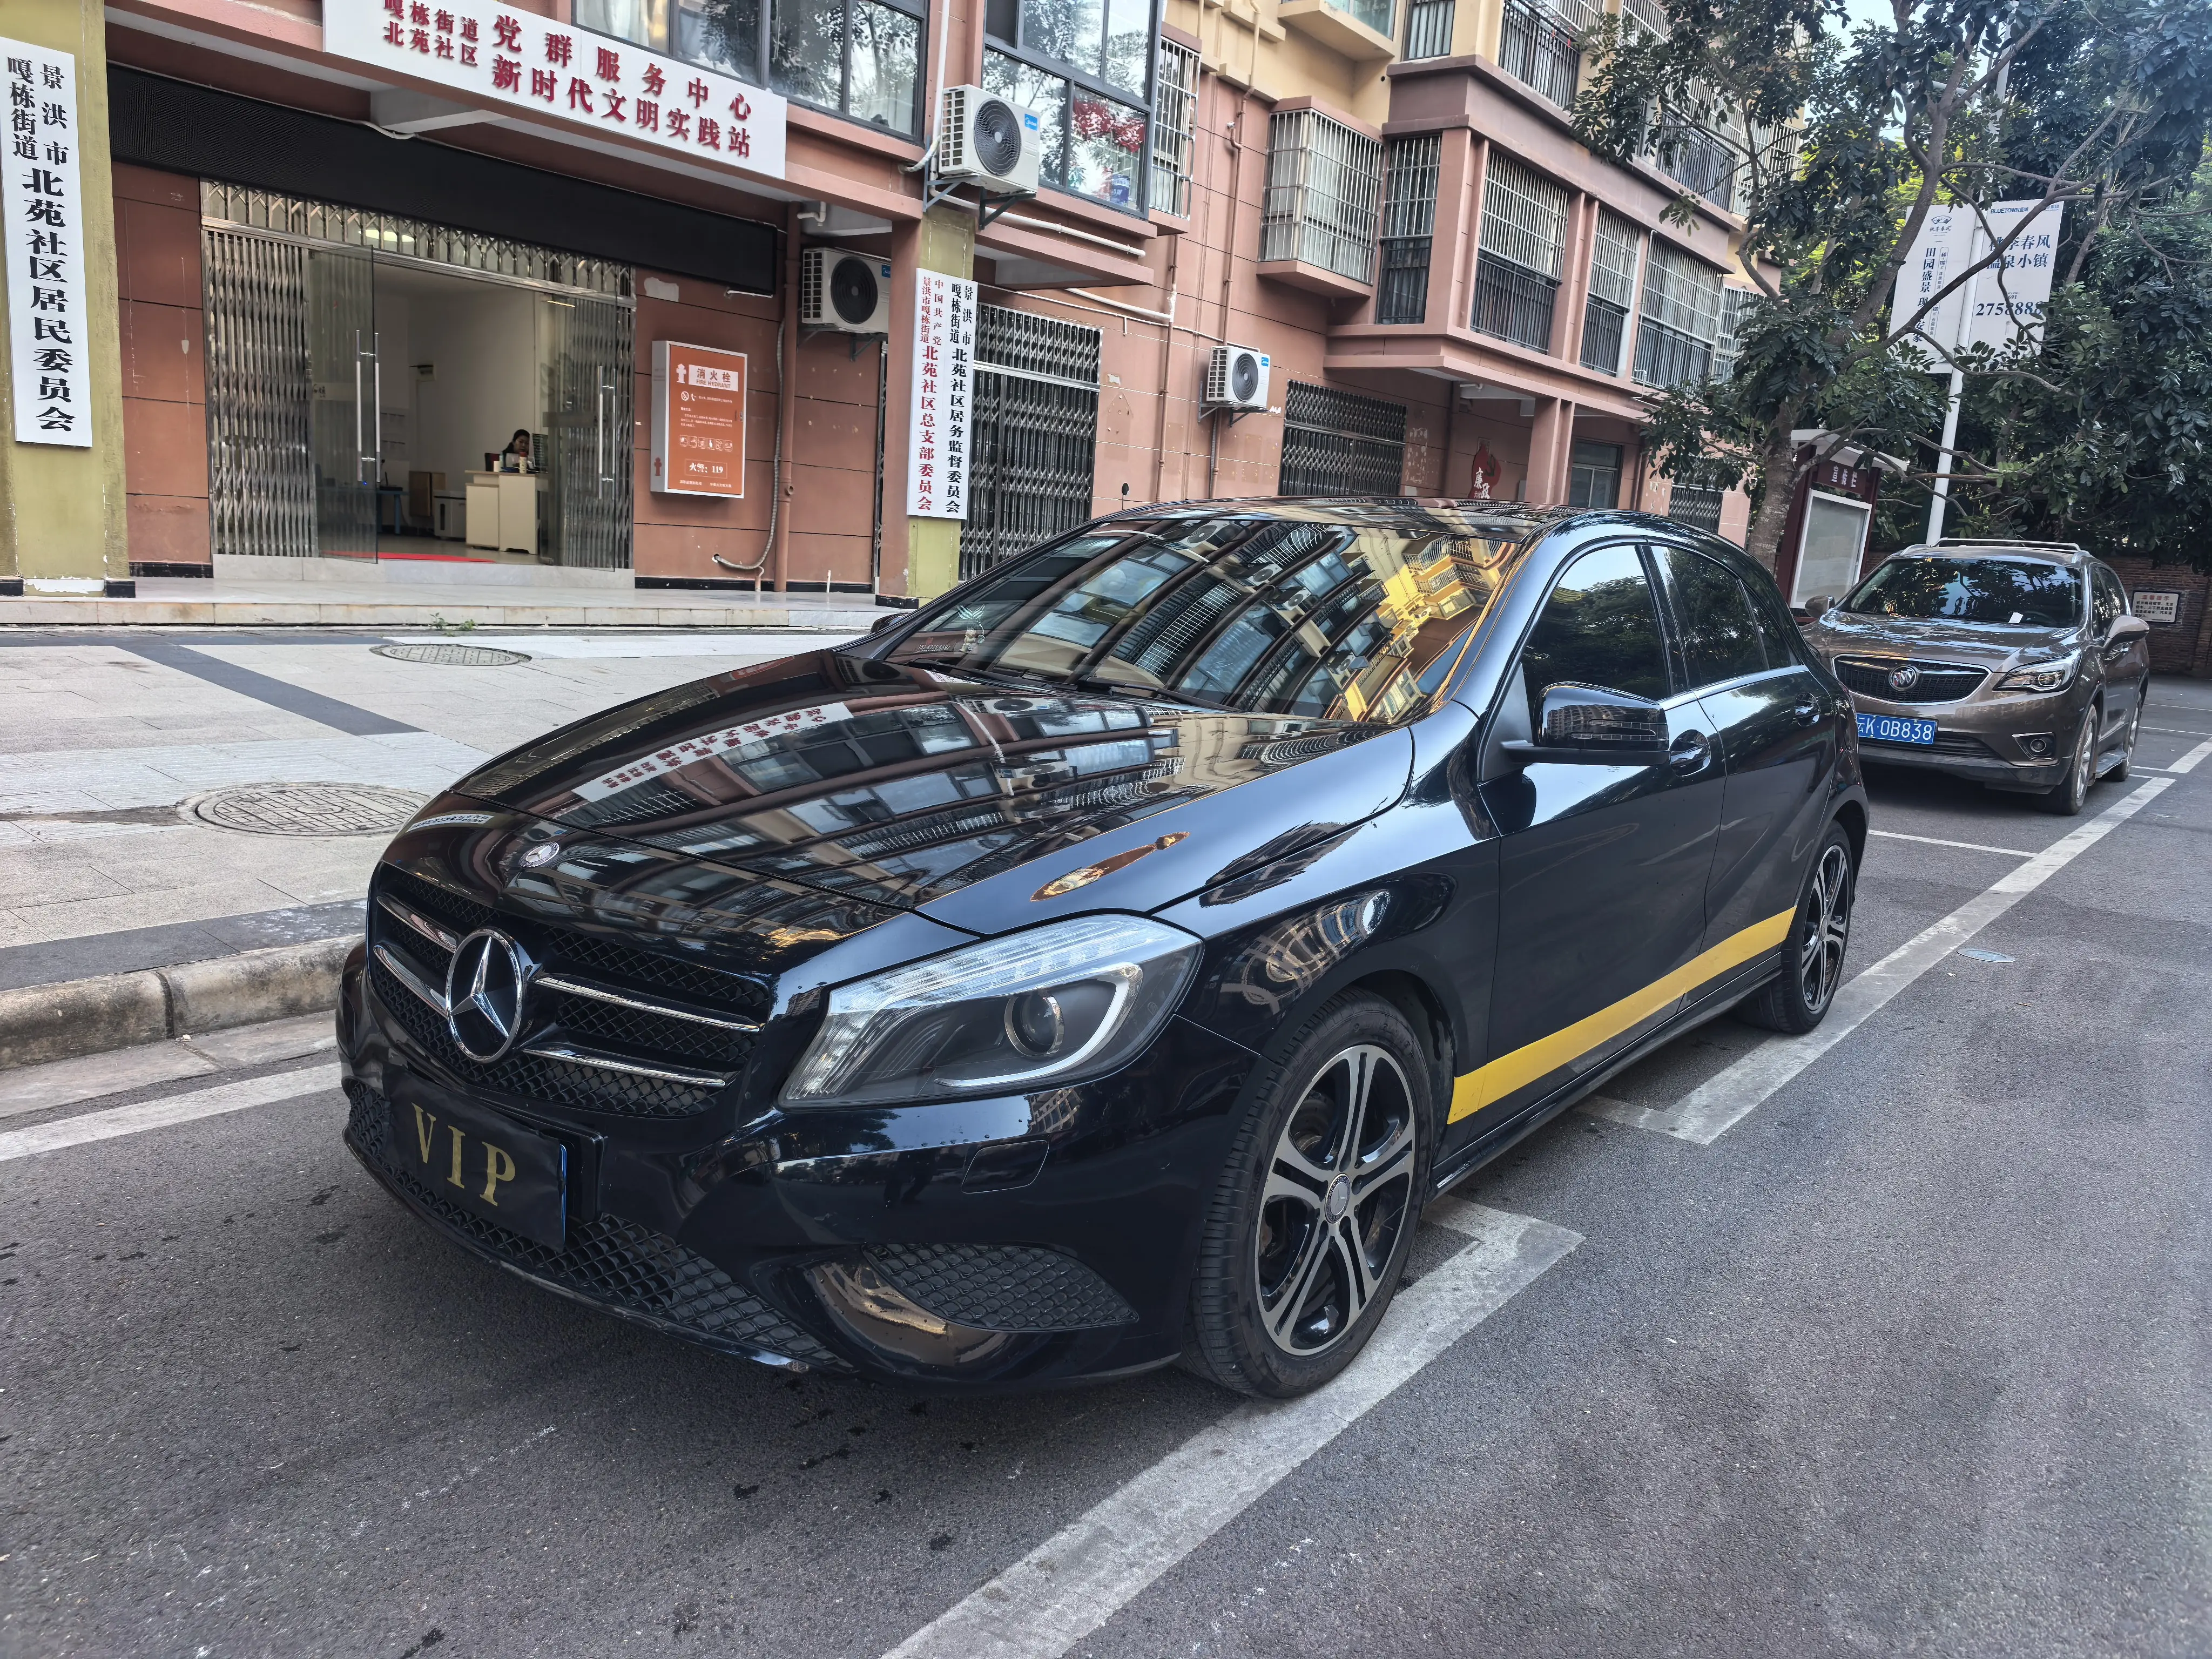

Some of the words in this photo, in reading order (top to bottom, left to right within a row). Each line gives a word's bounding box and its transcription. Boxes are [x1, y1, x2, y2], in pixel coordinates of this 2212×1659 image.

[383, 21, 478, 67] 北苑社区
[494, 15, 752, 120] 党群服务中心
[7, 56, 39, 161] 嘎栋街道
[39, 63, 69, 165] 景洪市
[493, 54, 751, 158] 新时代文明实践站
[22, 167, 77, 432] 北苑社区居民委员会
[920, 276, 932, 343] 景洪市嘎栋街道
[1920, 247, 1937, 293] 田园盛景
[932, 279, 944, 346] 中国共产党
[949, 283, 962, 344] 嘎栋街道
[962, 285, 974, 346] 景洪市
[697, 368, 731, 382] 消火栓
[707, 381, 731, 389] HYDRANT
[917, 346, 939, 510] 北苑社区总支部委员会
[945, 348, 968, 513] 北苑社区居务监督委员会
[411, 1102, 516, 1206] VIP
